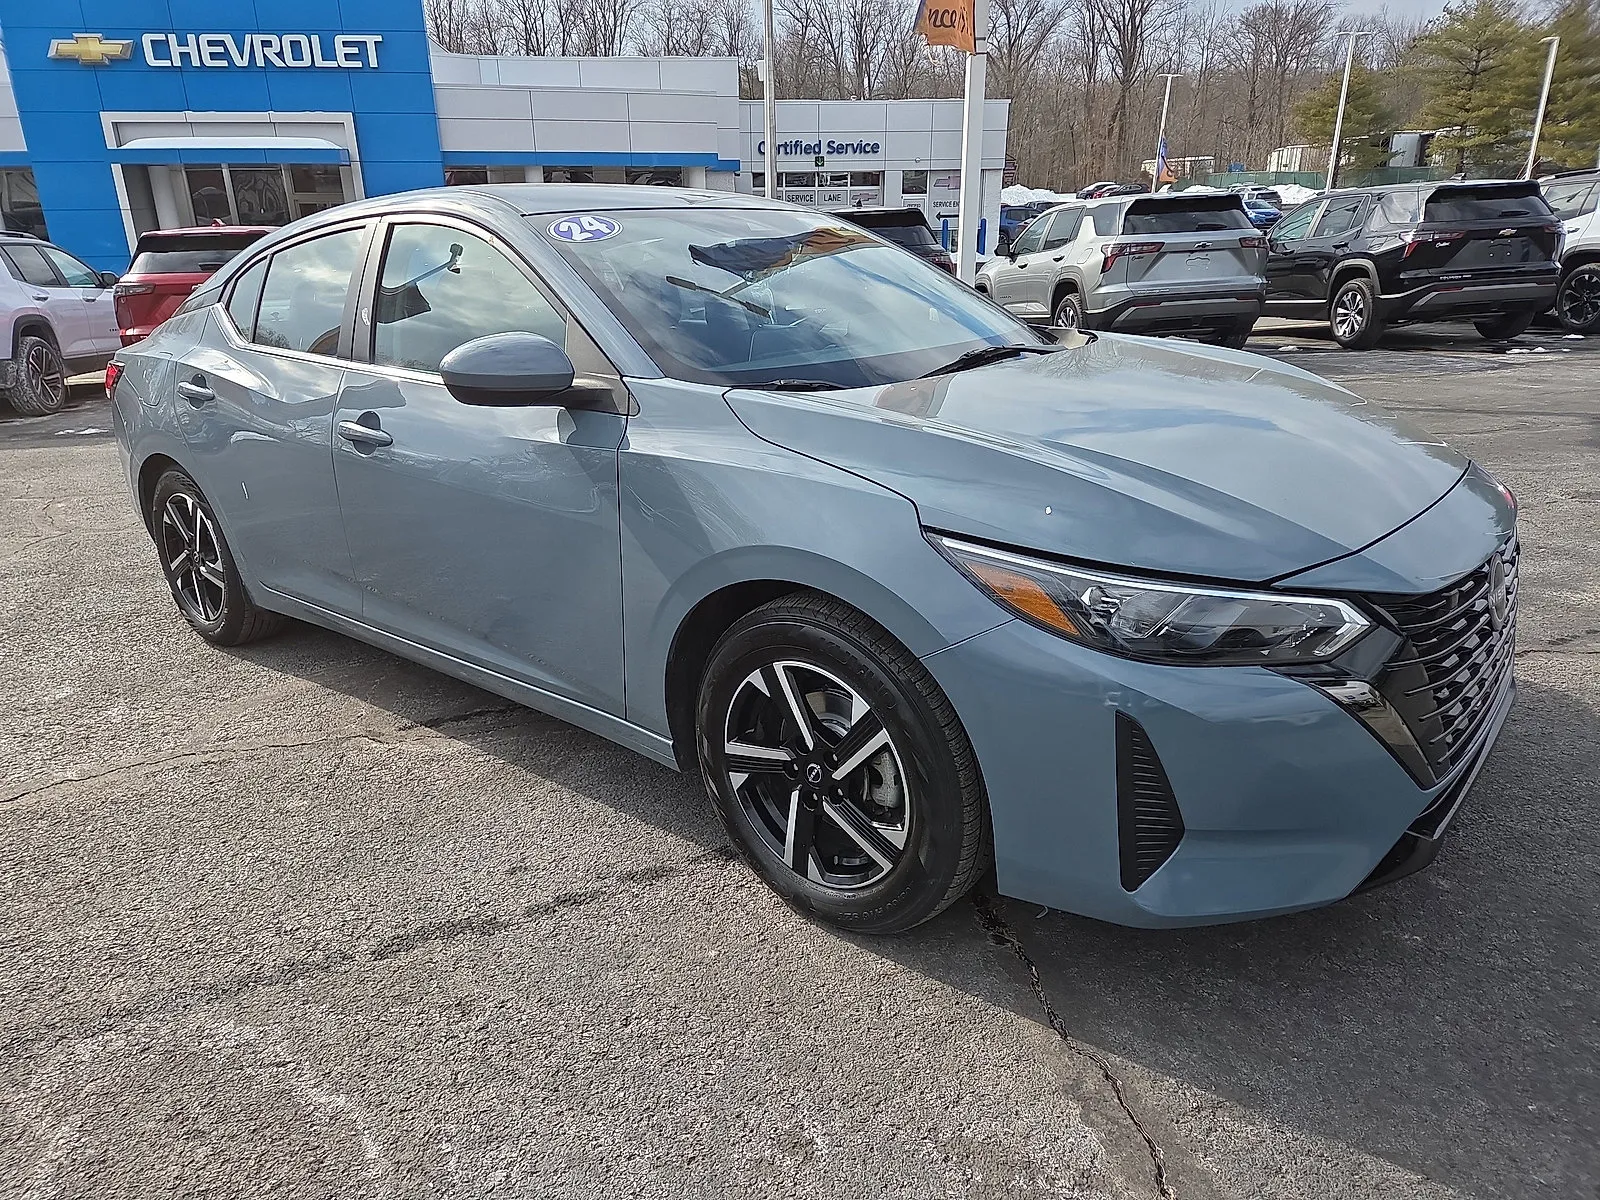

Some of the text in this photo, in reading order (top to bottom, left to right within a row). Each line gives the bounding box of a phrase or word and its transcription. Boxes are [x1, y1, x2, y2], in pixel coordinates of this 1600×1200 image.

[142, 33, 383, 68] CHEVROLET
[757, 139, 880, 156] Crtified Service
[787, 194, 814, 203] SERVICE
[823, 194, 842, 202] LANE
[932, 200, 952, 208] SERVICE
[558, 216, 613, 240] 24
